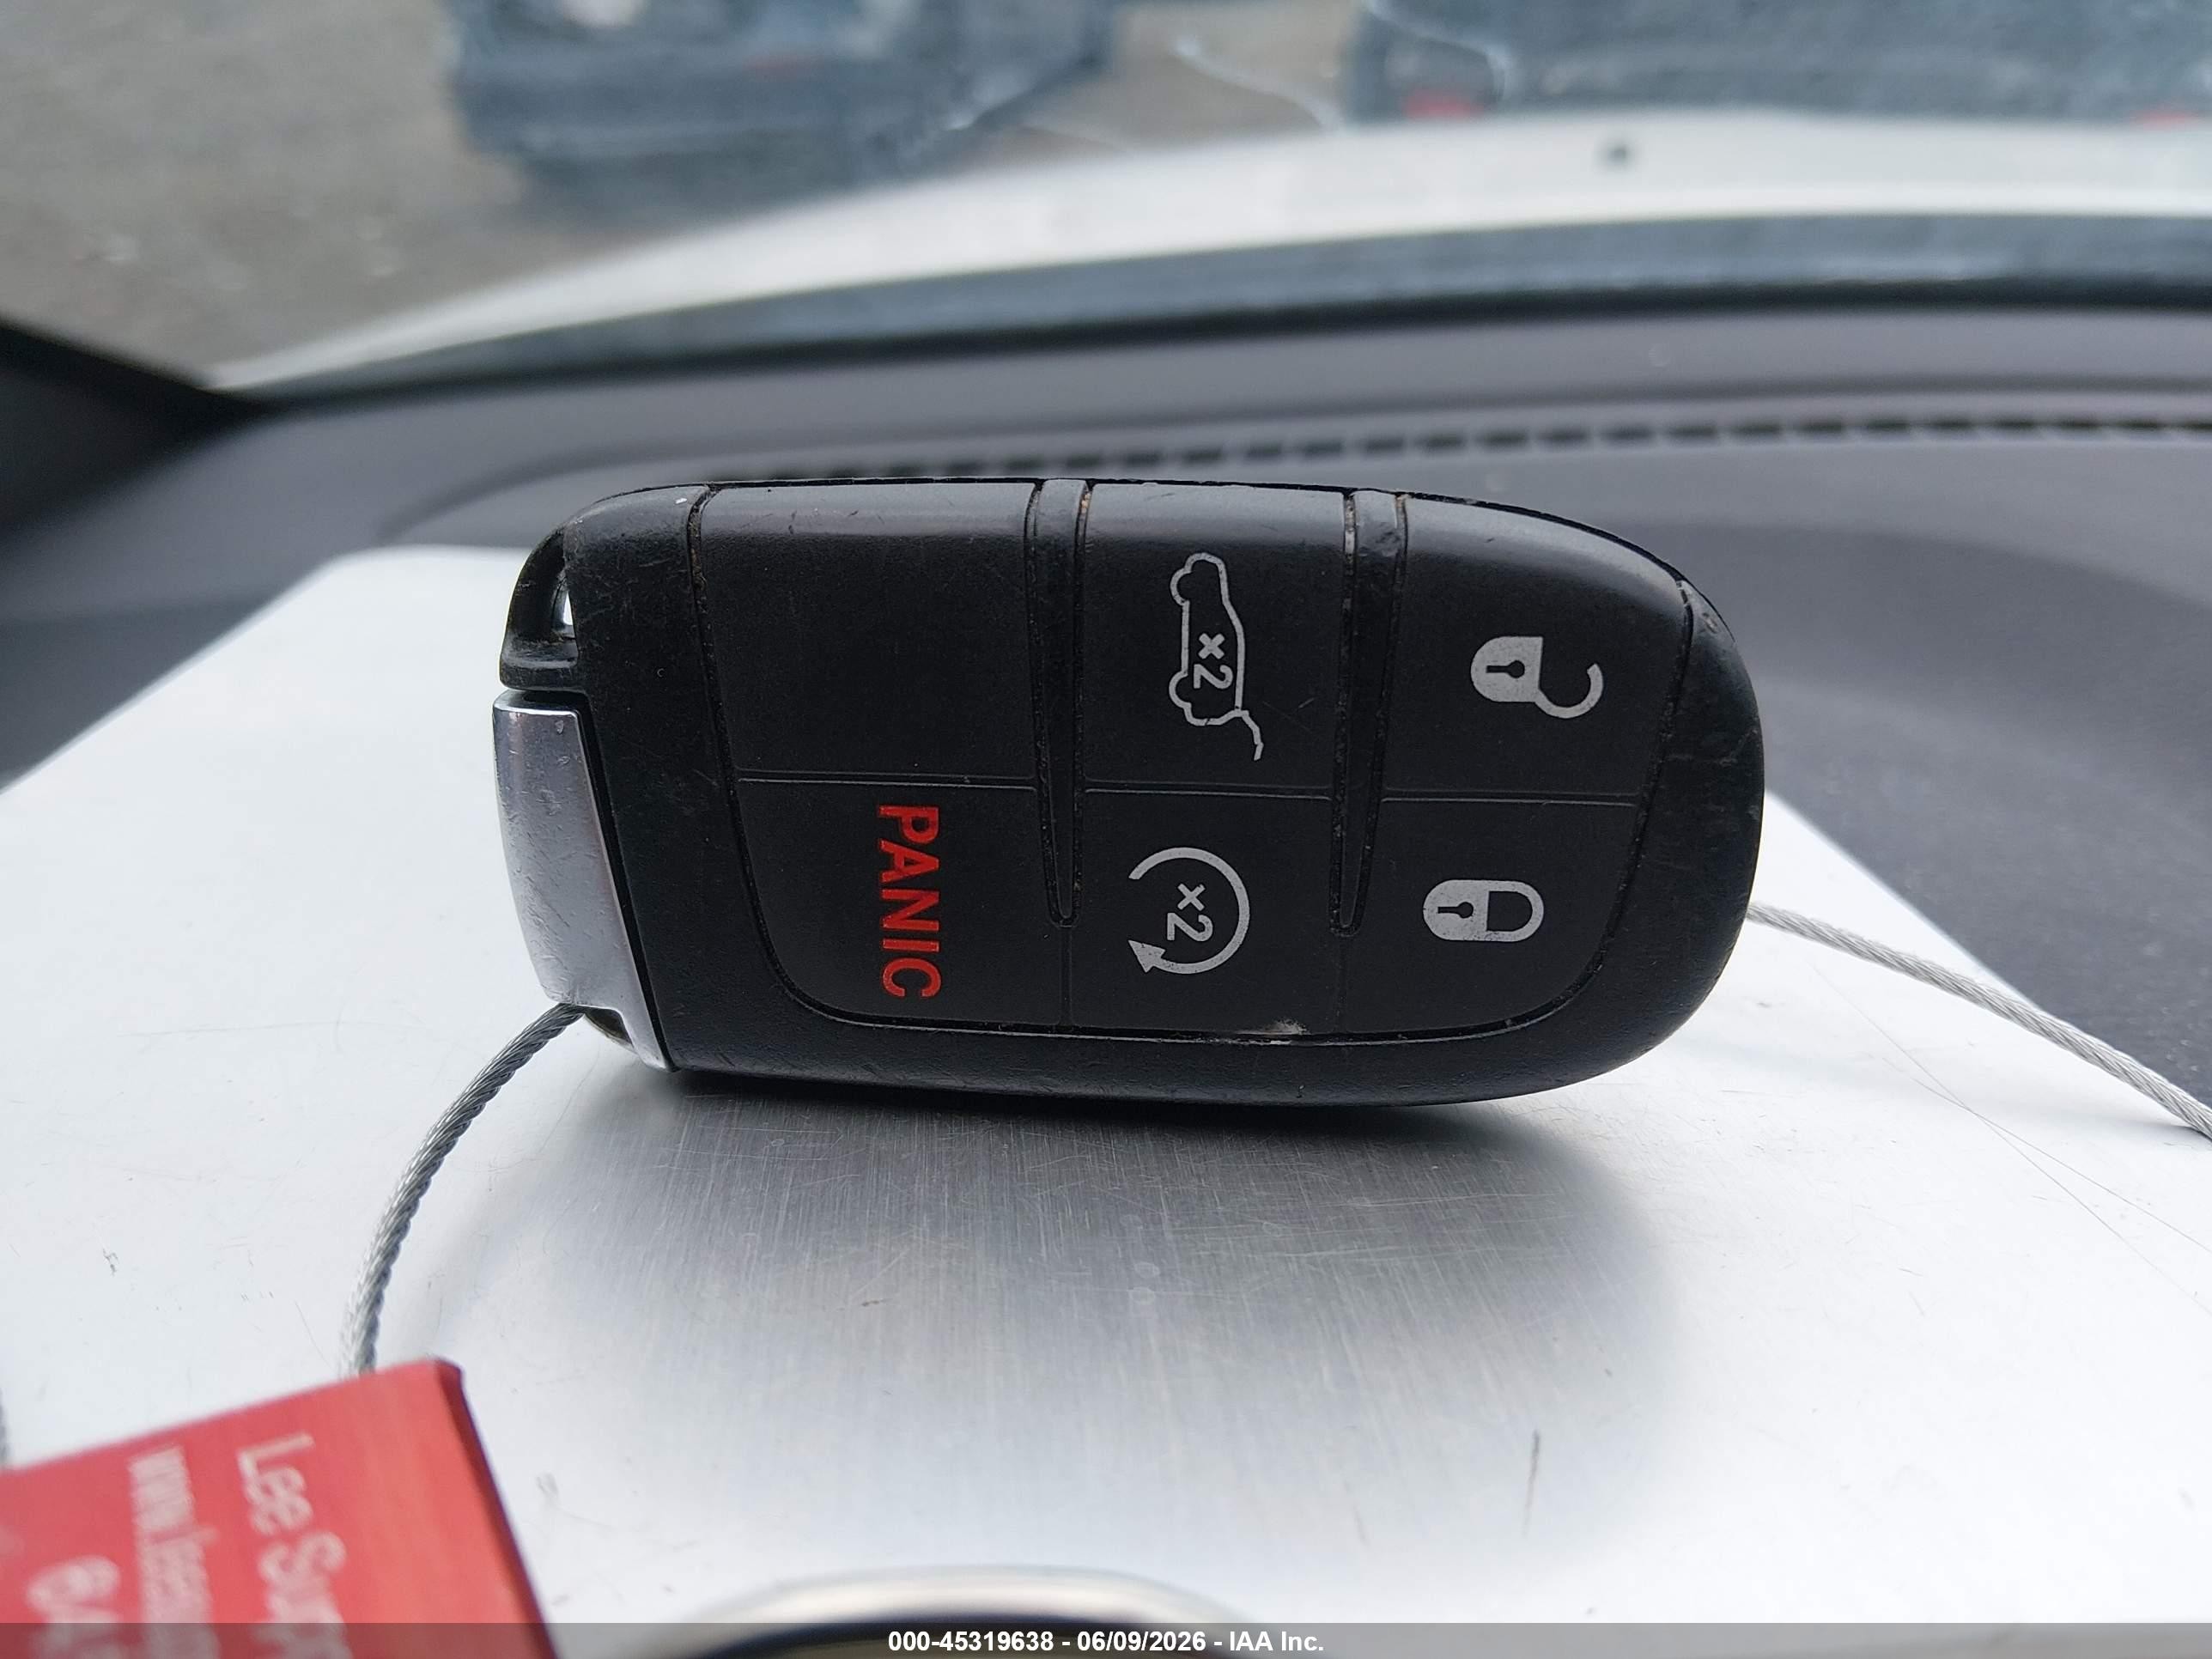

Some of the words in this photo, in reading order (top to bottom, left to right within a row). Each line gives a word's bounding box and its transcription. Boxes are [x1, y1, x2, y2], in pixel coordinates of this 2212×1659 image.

[1193, 632, 1234, 690] x2
[878, 805, 942, 998] PANIC
[1165, 882, 1214, 943] x2
[236, 1431, 315, 1535] Lee
